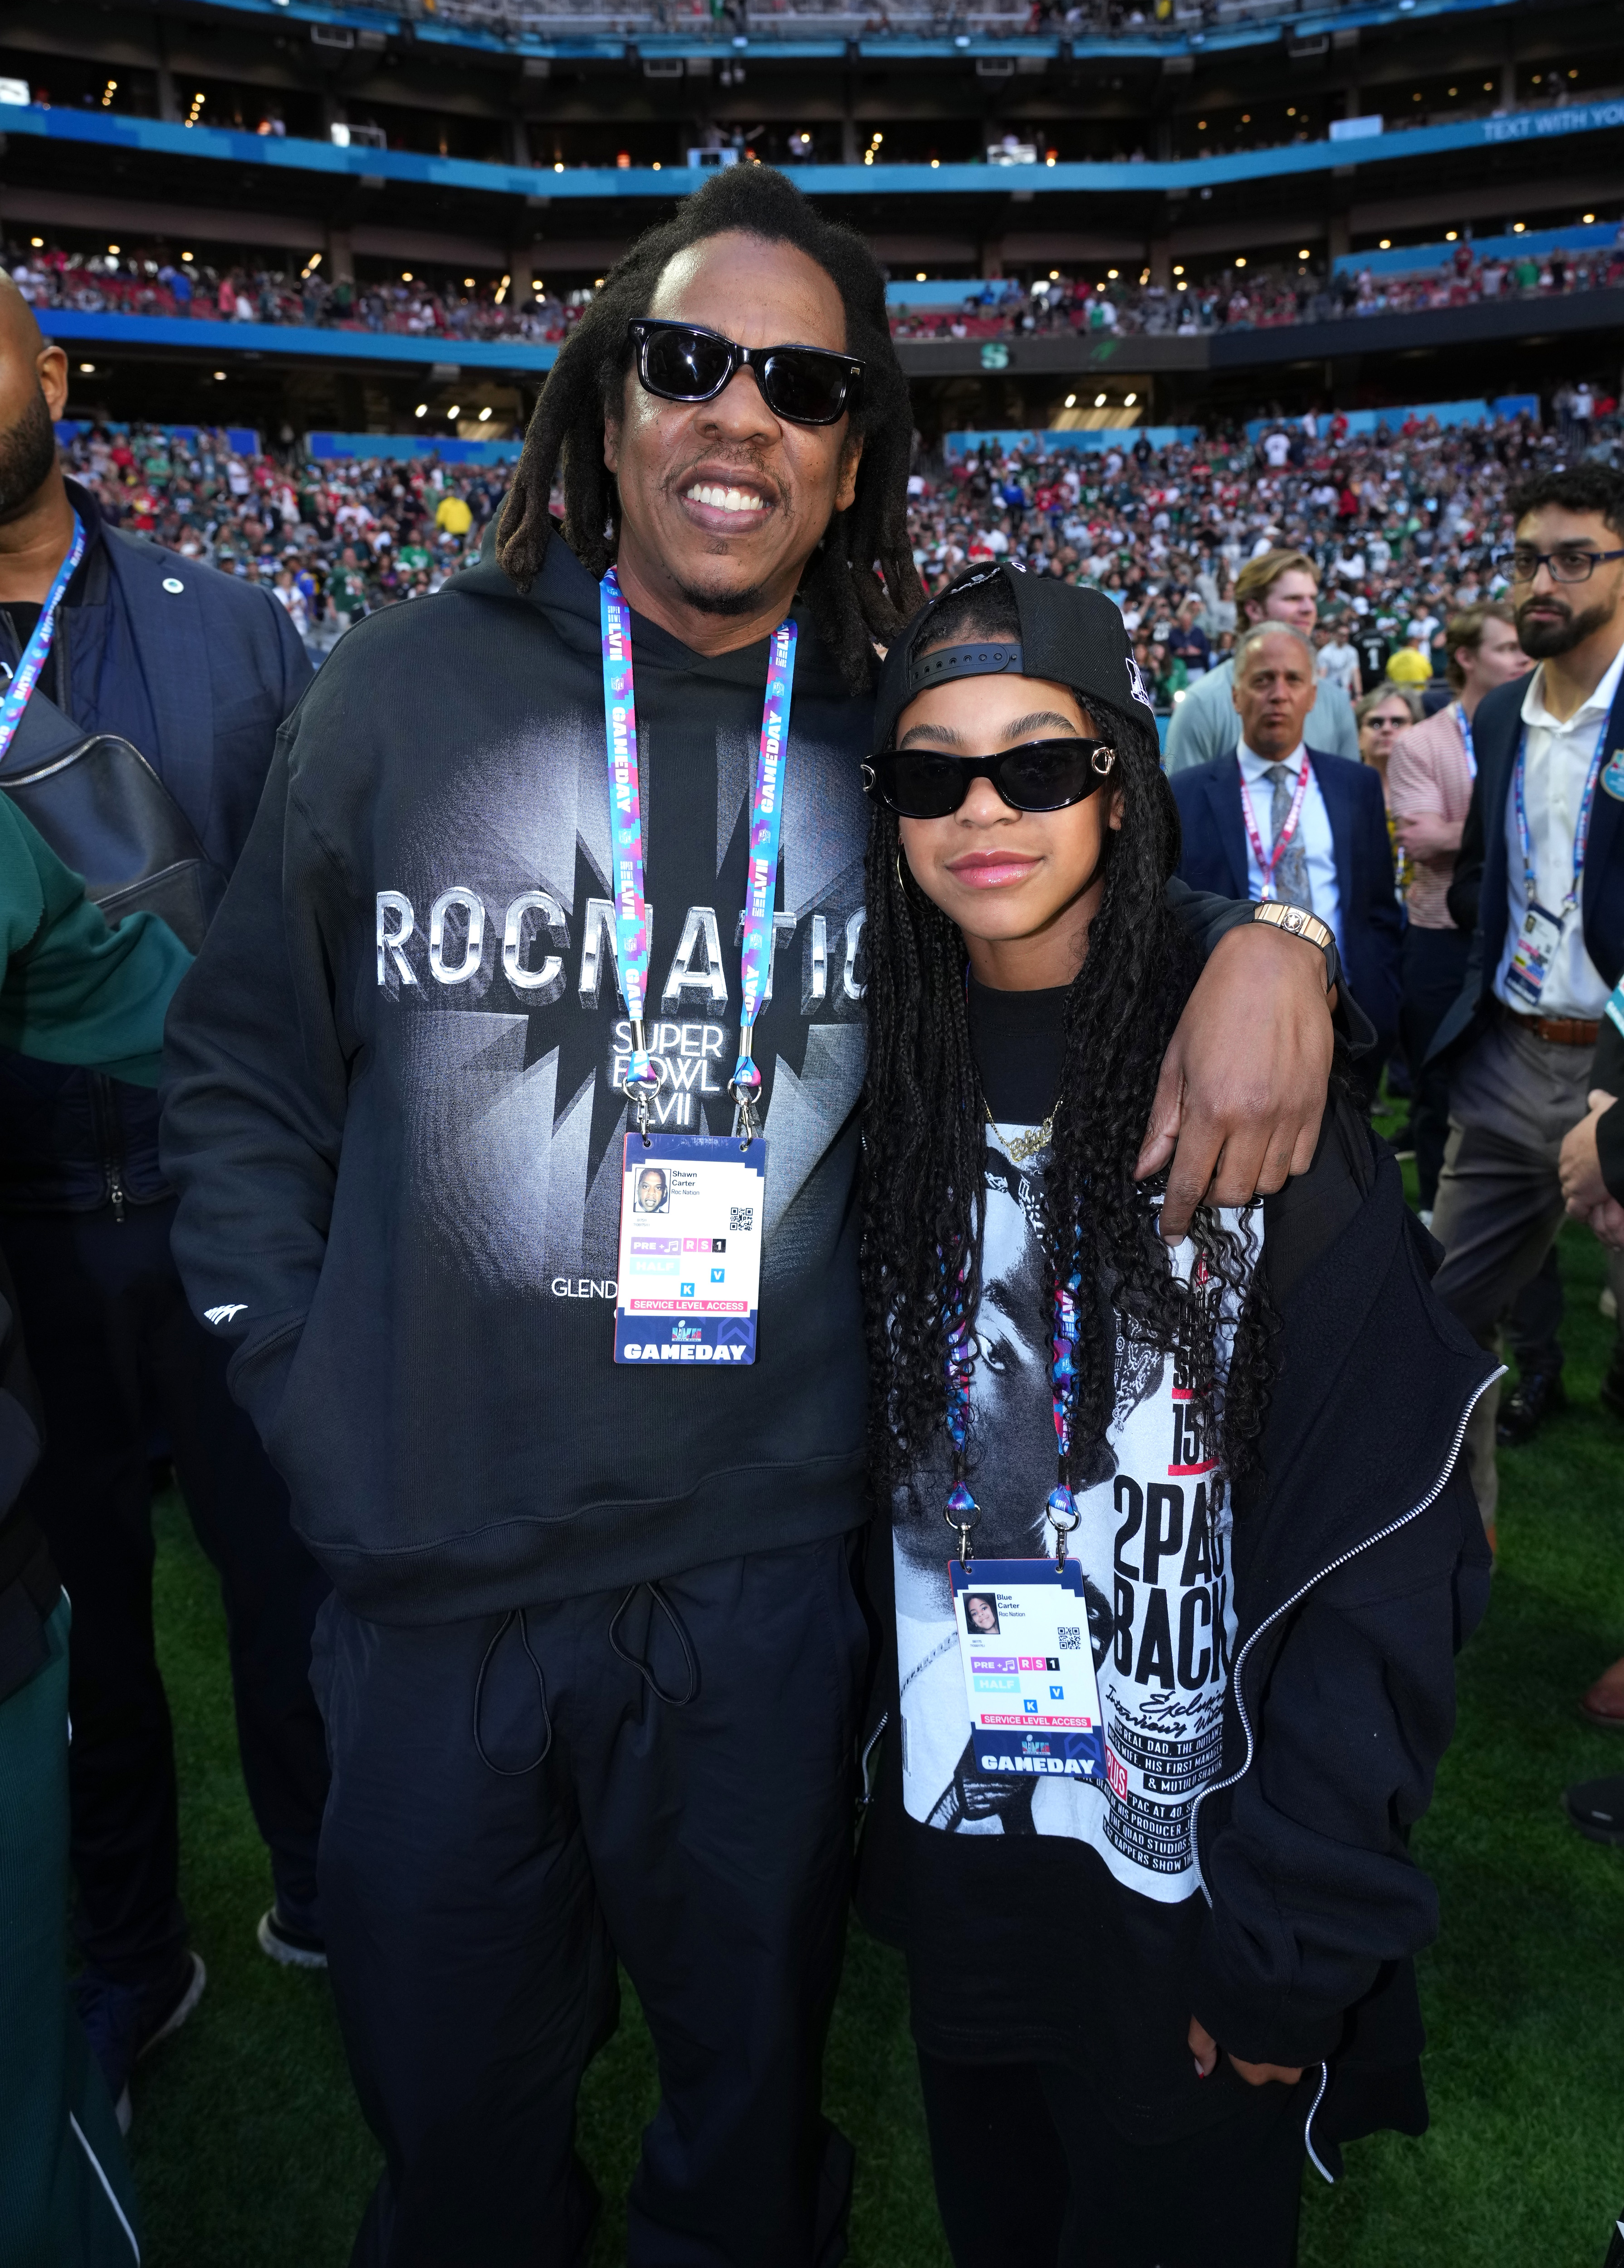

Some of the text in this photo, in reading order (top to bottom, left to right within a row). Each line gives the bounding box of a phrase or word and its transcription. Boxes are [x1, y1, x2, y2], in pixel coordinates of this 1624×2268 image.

[607, 605, 621, 614] SUPER
[608, 614, 621, 623] BOWL
[608, 623, 623, 661] LVII
[611, 707, 631, 813] GAMEDAY
[761, 710, 782, 814] GAMEDAY
[620, 861, 633, 871] SUPER
[621, 870, 633, 880] BOWL
[753, 859, 768, 898] LVII
[621, 880, 636, 920] LVII
[753, 898, 765, 908] BOWL
[752, 907, 765, 918] SUPER
[612, 1022, 723, 1058] SUPER
[613, 1056, 719, 1091] BOWL
[686, 1240, 695, 1249] R
[701, 1241, 709, 1250] S
[716, 1241, 722, 1250] 1
[636, 1261, 675, 1271] HALF
[713, 1271, 722, 1280] V
[683, 1285, 692, 1295] K
[634, 1301, 744, 1310] SERVICE LEVEL ACCESS
[623, 1344, 748, 1360] GAMEDAY
[1113, 1474, 1226, 1588] 2PAC
[1114, 1571, 1230, 1691] BACK
[1021, 1659, 1029, 1667] R
[1035, 1660, 1043, 1668] S
[1050, 1660, 1056, 1668] 1
[980, 1680, 1015, 1689] HALF
[1052, 1688, 1061, 1697] V
[1027, 1702, 1035, 1711] K
[984, 1715, 1087, 1727] SERVICE LEVEL ACCESS
[1115, 1718, 1123, 1734] HIS
[1124, 1727, 1144, 1749] REAL
[1177, 1741, 1194, 1755] THE
[1196, 1725, 1223, 1750] OUTLAWZ
[981, 1755, 1096, 1774] GAMEDAY
[1145, 1758, 1163, 1772] HIS
[1166, 1760, 1192, 1774] FIRST
[1195, 1741, 1223, 1769] MANAGER
[1107, 1750, 1125, 1796] PLUS
[1148, 1759, 1223, 1792] & MUTULU SHAKUR
[1096, 1778, 1111, 1800] DEATH
[1110, 1795, 1117, 1808] OF
[1118, 1804, 1129, 1820] HIS
[1153, 1806, 1165, 1818] AT
[1111, 1812, 1121, 1829] THE
[1123, 1824, 1145, 1845] QUAD
[1147, 1838, 1187, 1854] STUDIOS
[1114, 1835, 1149, 1865] RAPPERS
[1152, 1858, 1181, 1871] SHOW
